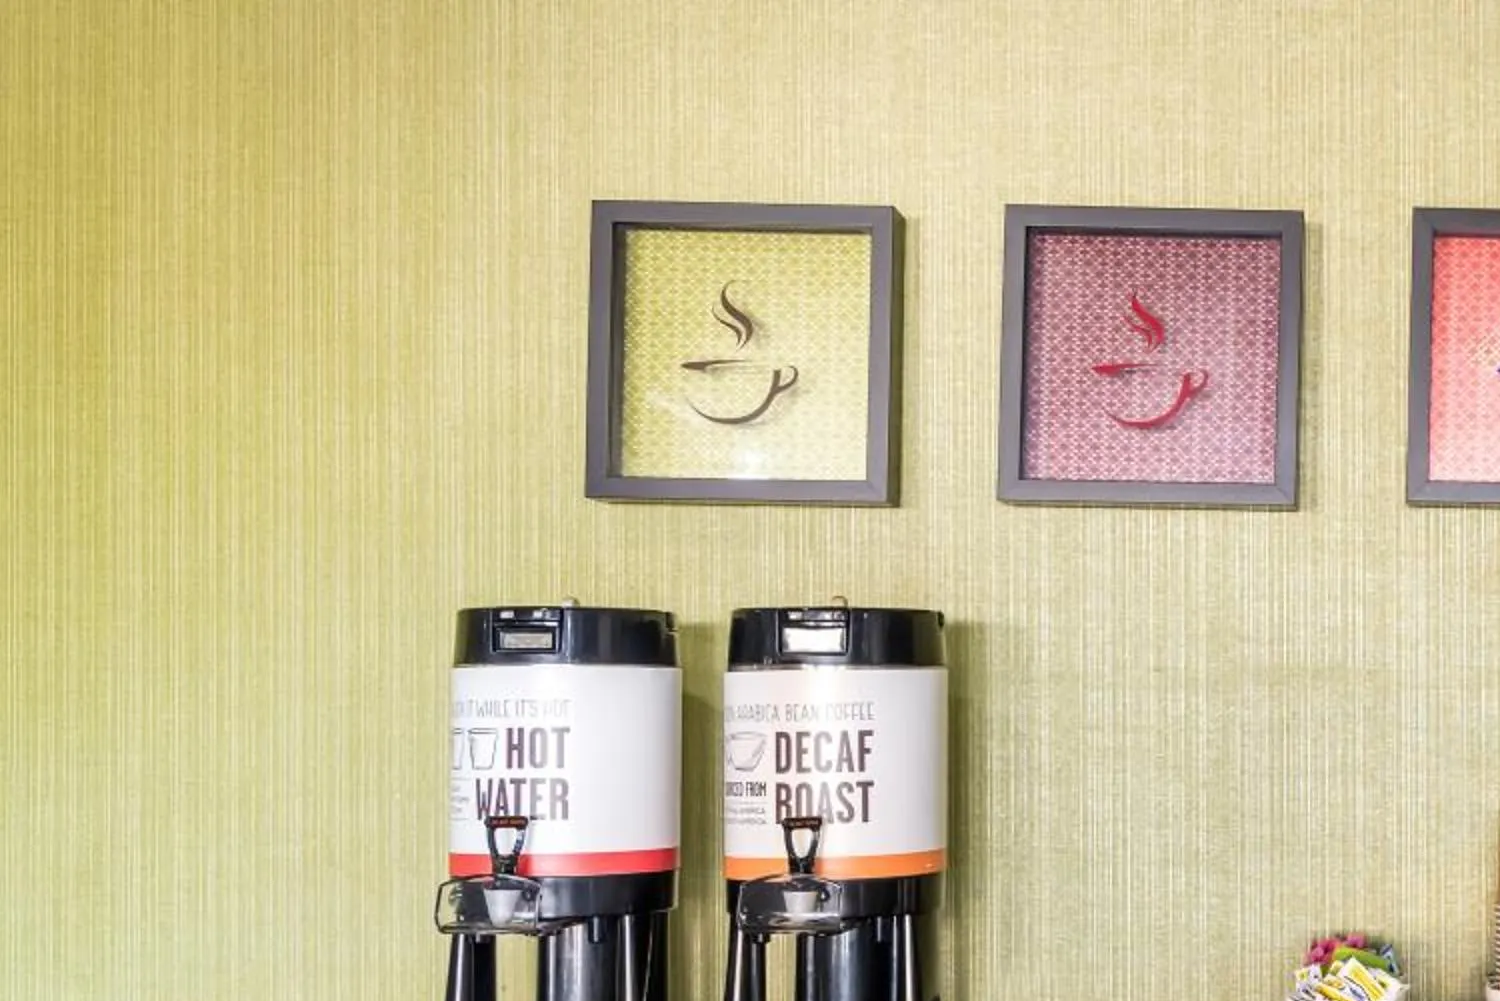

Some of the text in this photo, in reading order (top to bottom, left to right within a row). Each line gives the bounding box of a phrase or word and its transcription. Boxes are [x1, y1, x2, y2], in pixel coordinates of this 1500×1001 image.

[506, 727, 571, 769] HOT
[775, 729, 875, 774] DECAF
[475, 777, 569, 821] WATER
[775, 780, 875, 824] ROAST
